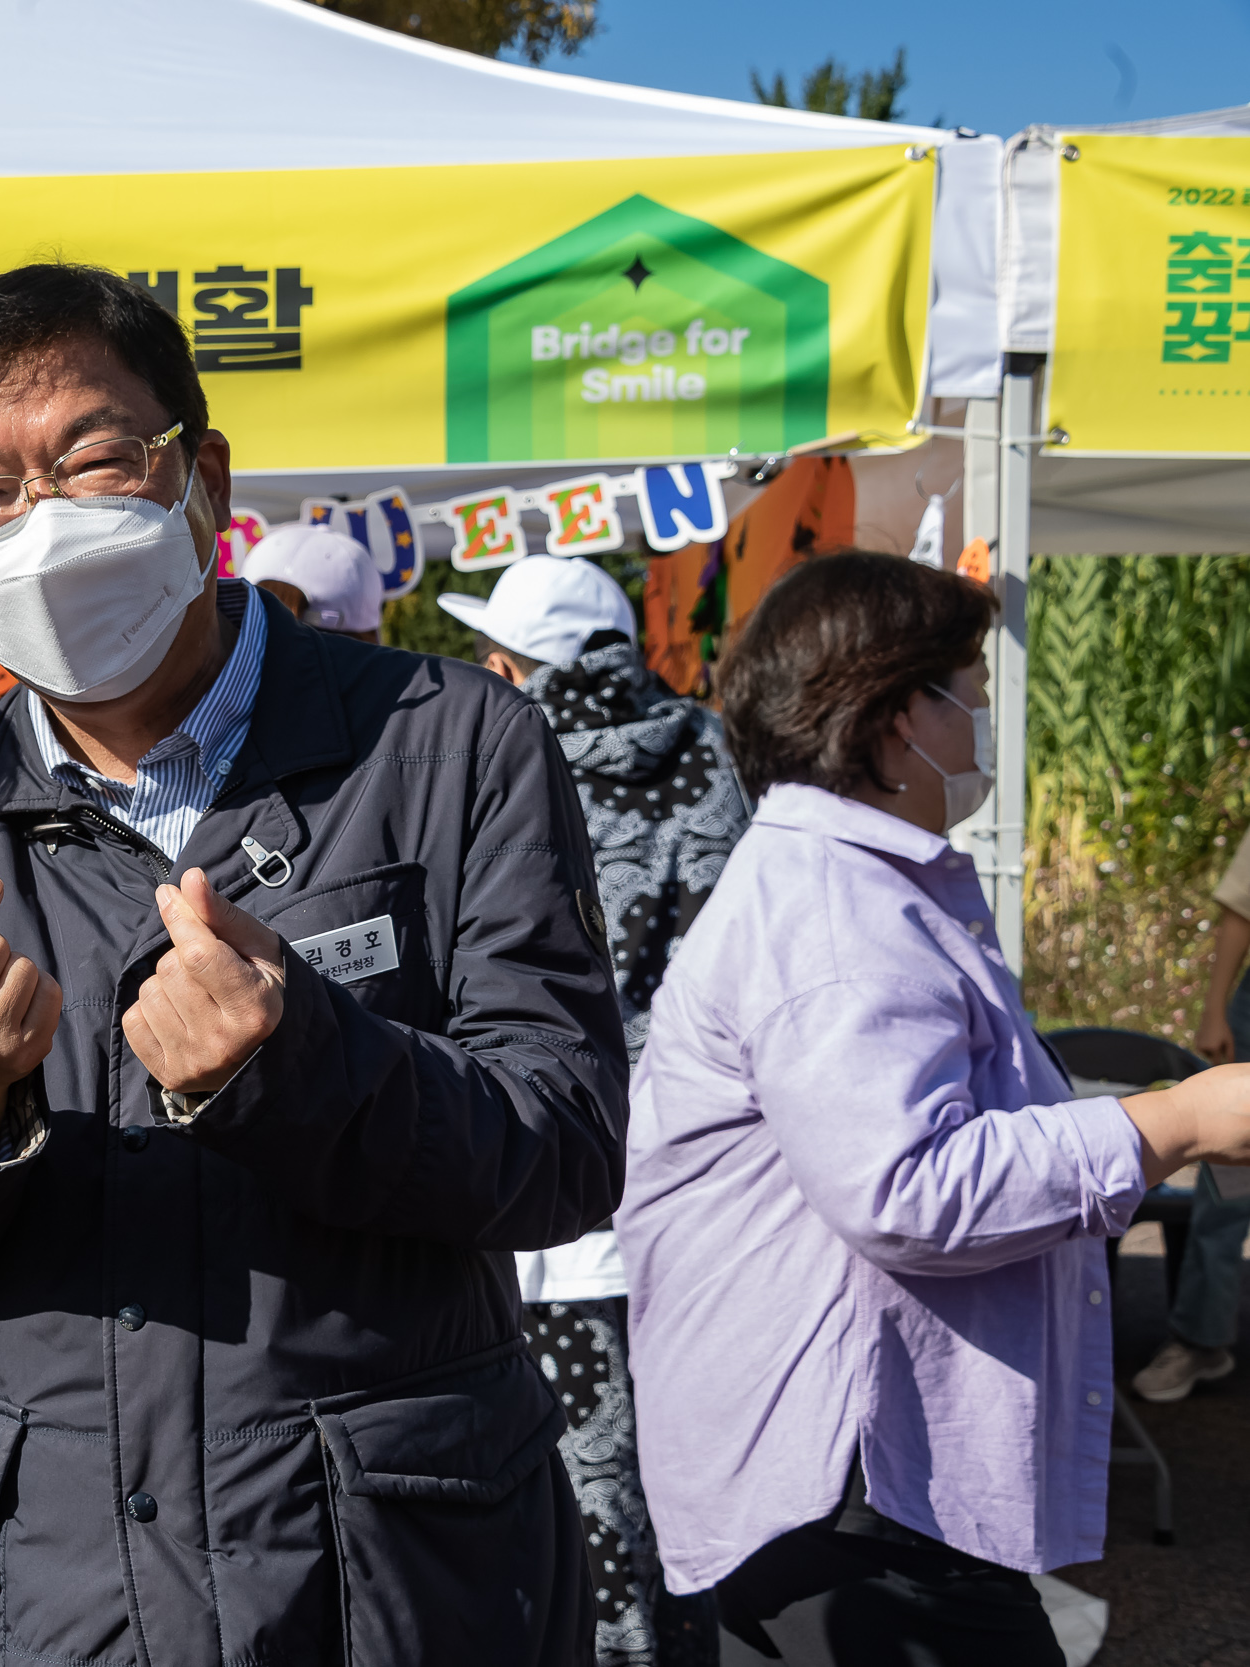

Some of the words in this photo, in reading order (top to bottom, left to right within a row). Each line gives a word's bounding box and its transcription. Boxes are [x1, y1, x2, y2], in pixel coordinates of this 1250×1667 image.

[1167, 187, 1236, 206] 2022
[1167, 231, 1250, 294] 춤
[531, 321, 676, 366] Bridge
[685, 319, 750, 356] for
[1162, 301, 1250, 363] 꿈
[580, 364, 707, 403] Smile
